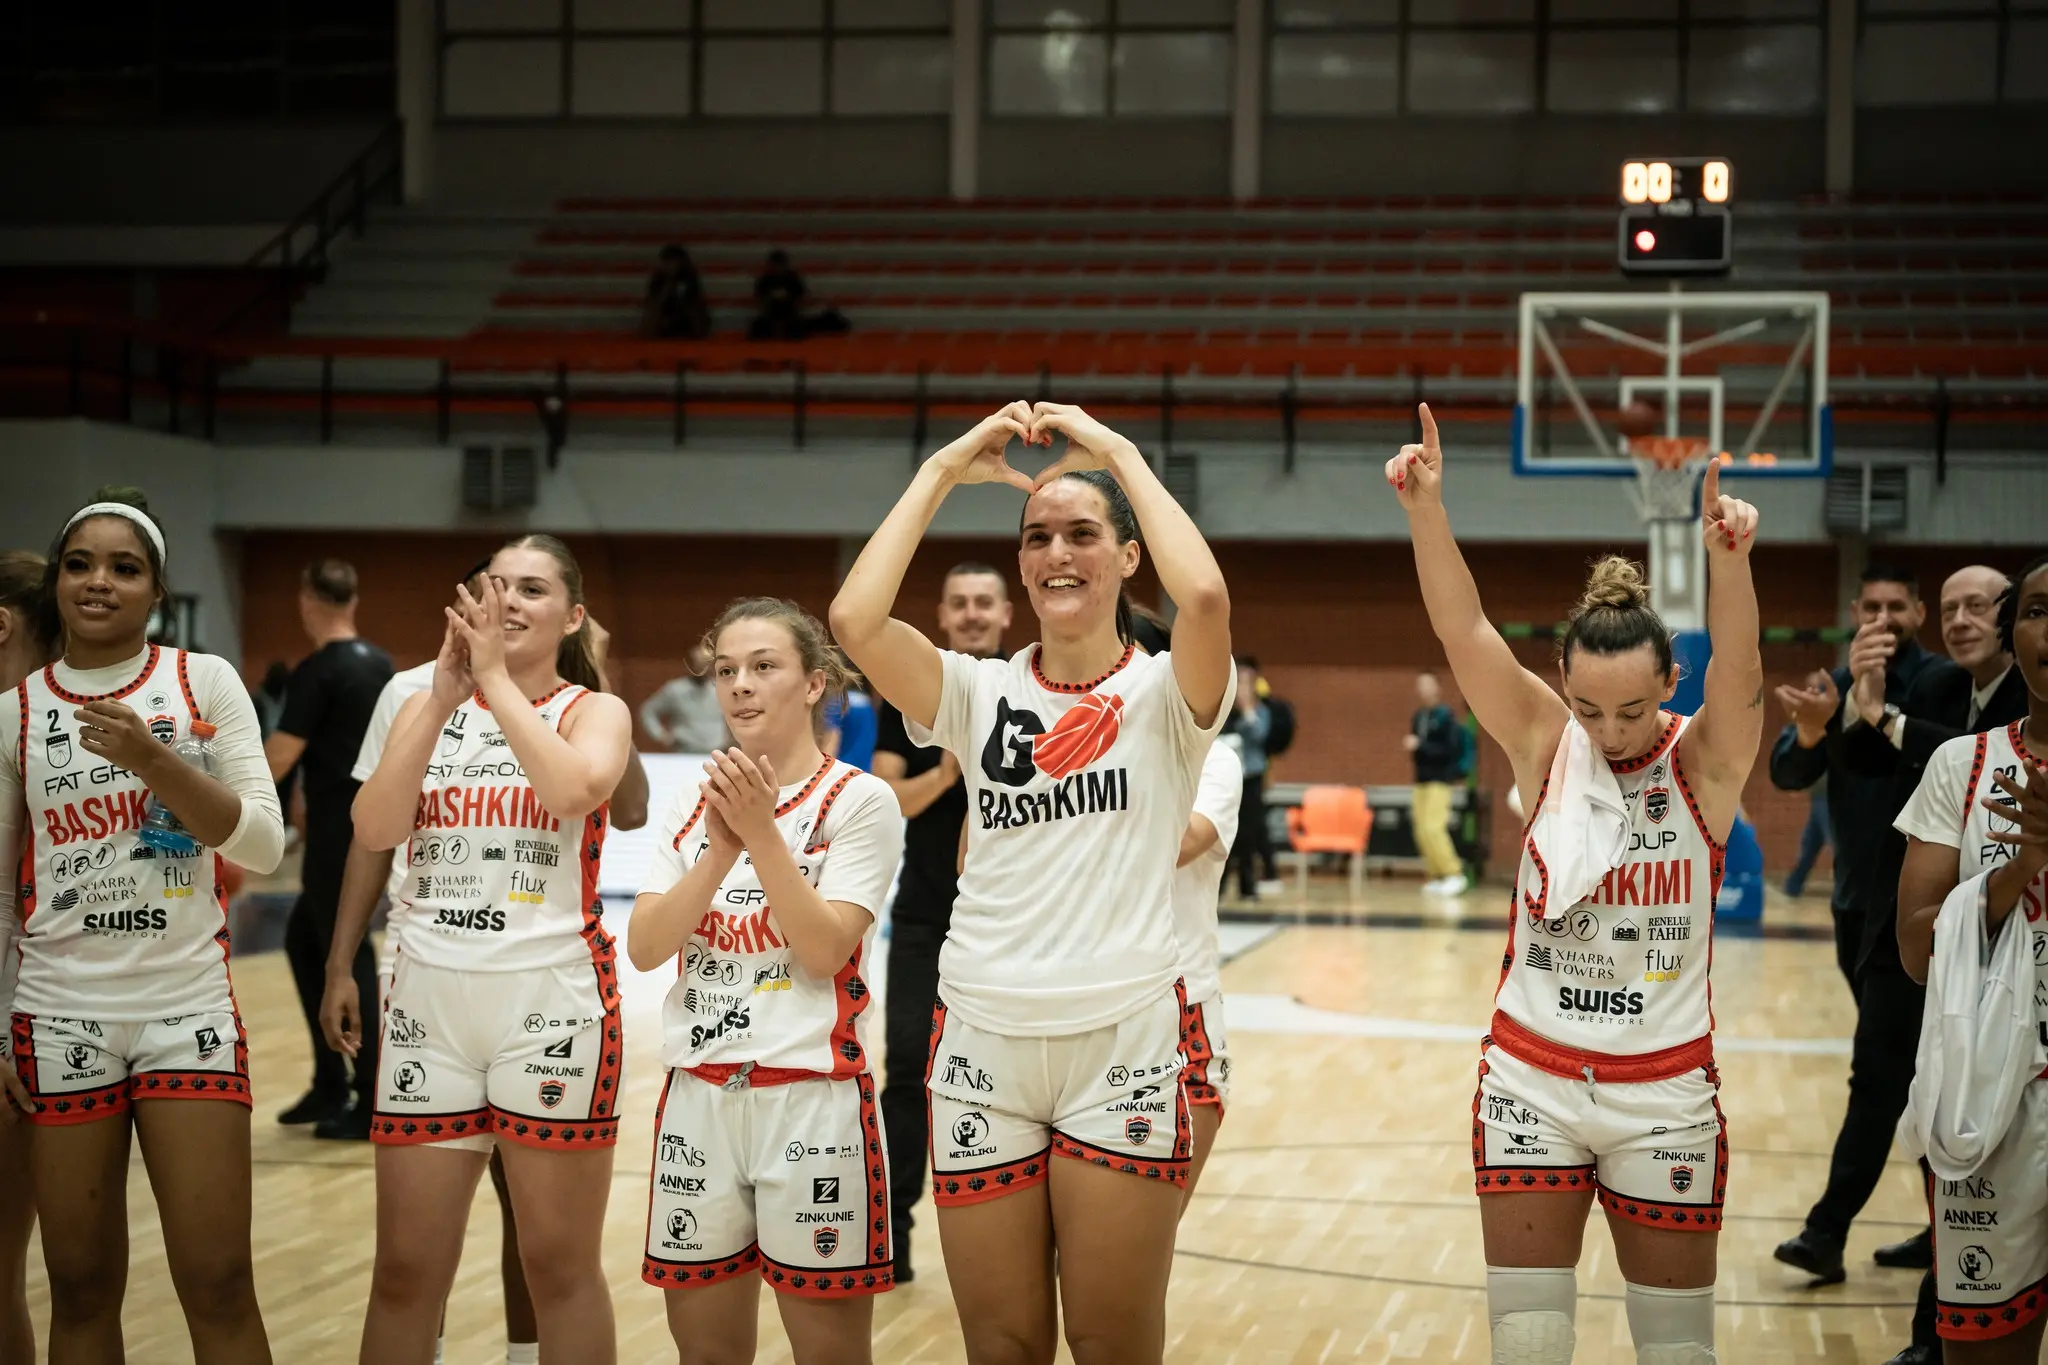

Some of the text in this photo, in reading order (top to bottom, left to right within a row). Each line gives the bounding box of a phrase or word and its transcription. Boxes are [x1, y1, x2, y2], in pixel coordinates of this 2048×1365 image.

[47, 709, 61, 732] 2
[44, 762, 140, 797] FAT GR
[978, 767, 1128, 830] BASHKIMI
[514, 850, 559, 867] TAHIRI
[163, 866, 194, 887] flu
[510, 870, 547, 894] flux
[434, 888, 482, 899] TOWERS
[83, 903, 167, 932] SWISS
[433, 904, 506, 932] SWISS
[1555, 949, 1615, 967] XHARRA
[1645, 950, 1683, 971] flux
[1554, 962, 1615, 980] TOWERS
[1559, 986, 1644, 1016] SWISS
[1556, 1012, 1645, 1026] HOMESTORE
[62, 1068, 106, 1081] METALIKU
[524, 1063, 584, 1077] ZINKUNIE
[940, 1065, 994, 1093] DENIS
[1488, 1094, 1517, 1107] HOTEL
[1488, 1103, 1539, 1125] DENIS
[662, 1133, 687, 1146] HOTEL
[660, 1144, 706, 1168] DENIS
[949, 1146, 997, 1159] METALIKU
[1504, 1146, 1549, 1155] METALIKU
[1652, 1150, 1706, 1163] ZINKUNIE
[659, 1172, 706, 1192] ANNEX
[1942, 1176, 1996, 1200] DENIS
[795, 1211, 855, 1223] ZINKUNIE
[1943, 1208, 1999, 1226] ANNEX
[661, 1240, 703, 1251] METALIKU
[1955, 1283, 2002, 1291] METALIKU
